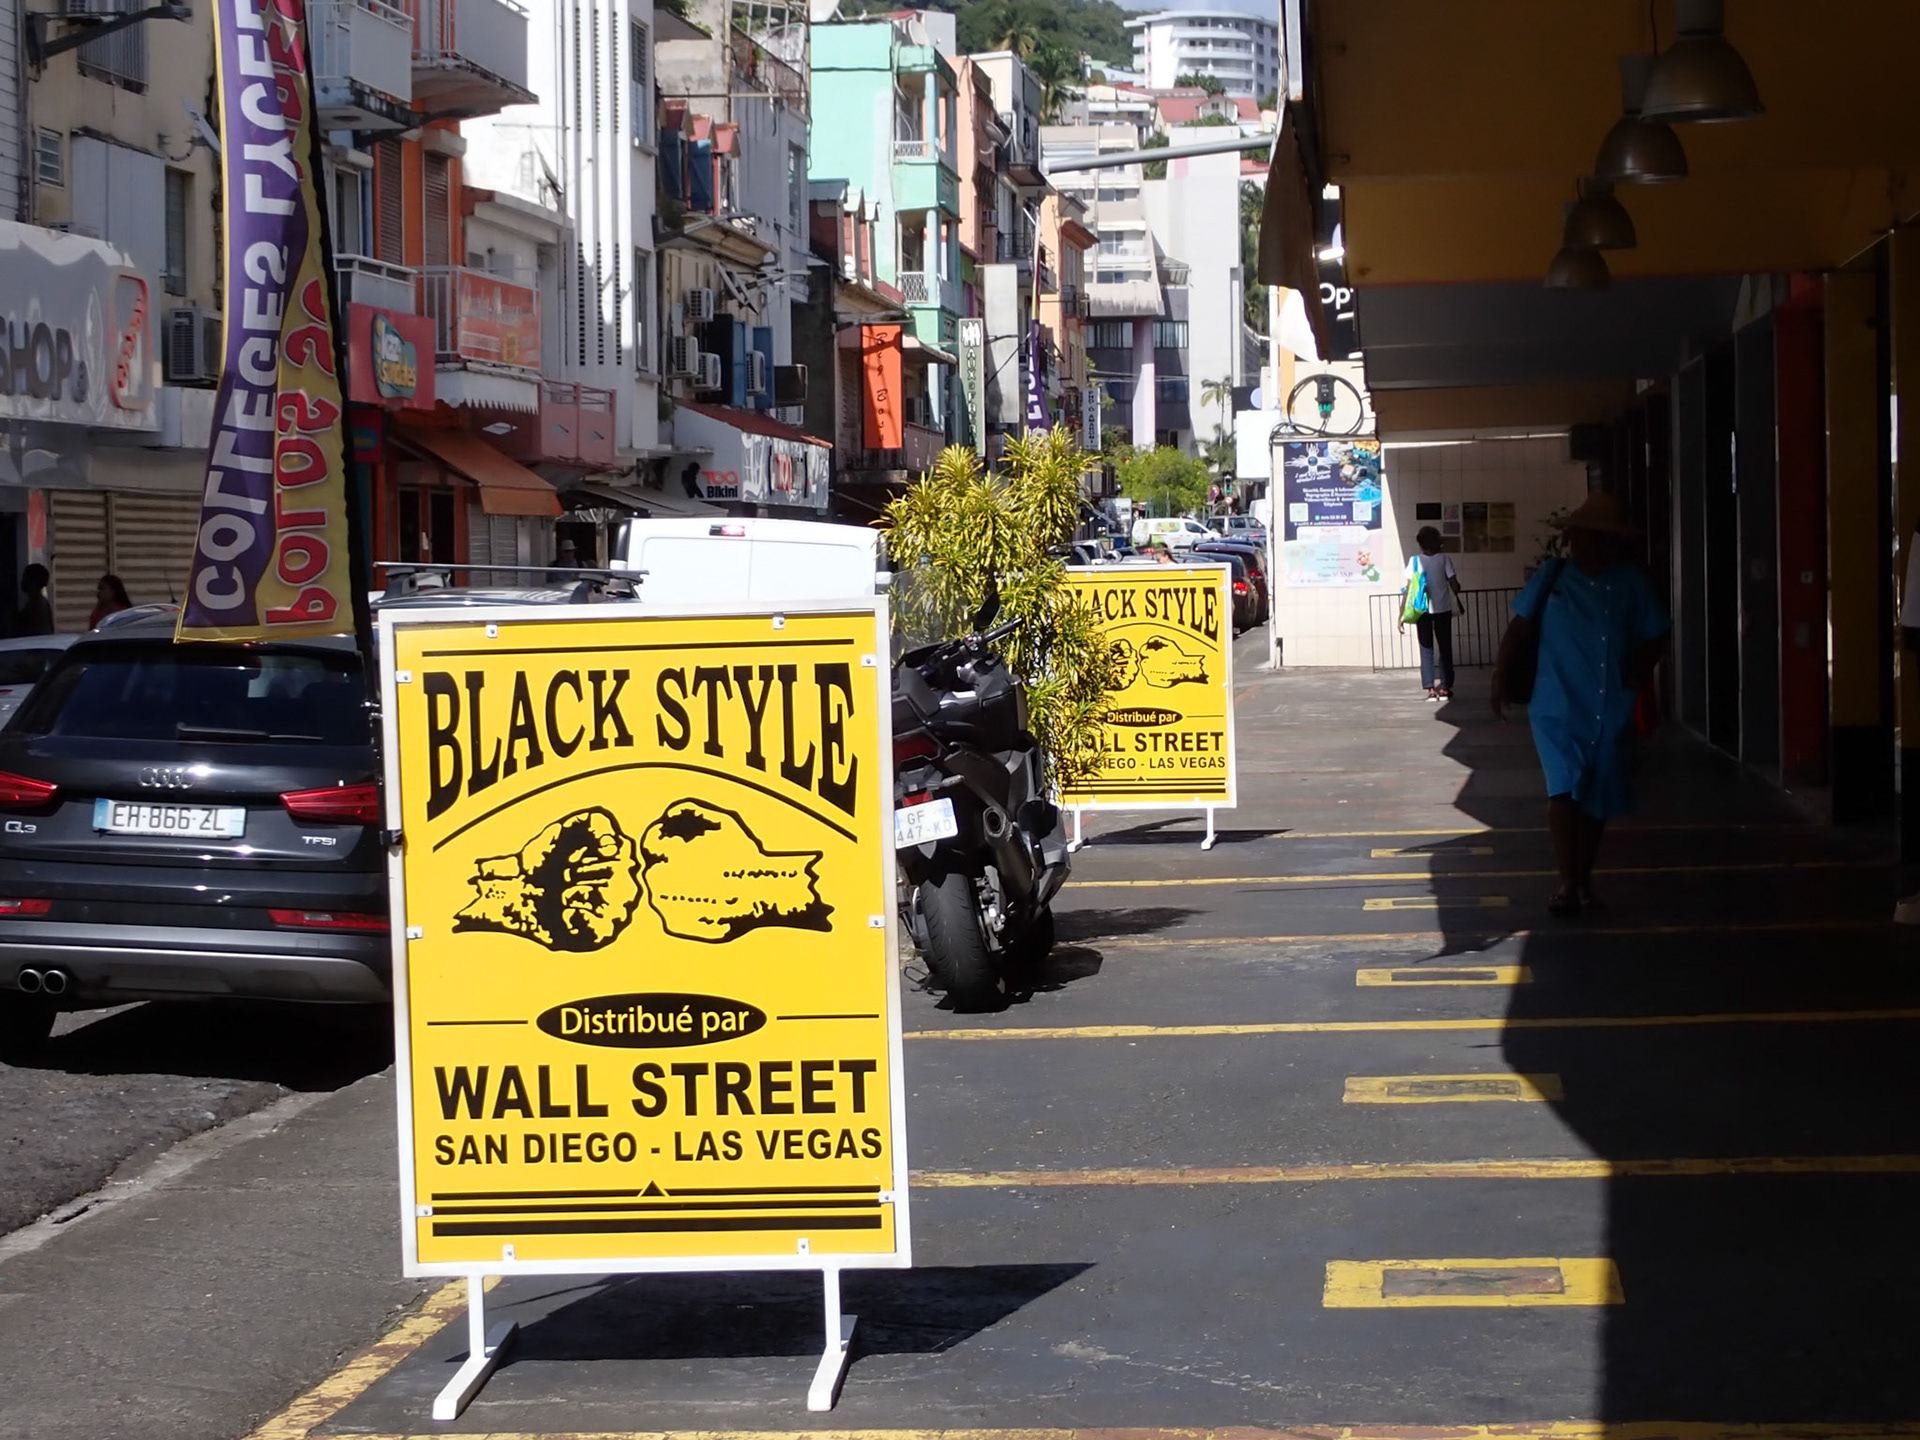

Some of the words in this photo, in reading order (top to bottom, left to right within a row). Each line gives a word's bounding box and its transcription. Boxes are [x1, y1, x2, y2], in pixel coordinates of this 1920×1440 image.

[1319, 282, 1354, 310] Op
[706, 485, 739, 499] Bikini
[1061, 588, 1136, 625] ACK
[1145, 587, 1219, 642] STYLE
[1107, 711, 1156, 723] Distribué
[1158, 713, 1177, 725] par
[422, 668, 634, 823] BLACK
[655, 662, 858, 818] STYLE
[1134, 731, 1224, 753] STREET
[1099, 757, 1137, 769] IEGO
[1149, 757, 1175, 769] LAS
[1179, 756, 1226, 769] VEGAS
[5, 821, 37, 834] Q3
[907, 810, 926, 825] GF
[301, 835, 337, 847] TFSI
[560, 1004, 693, 1035] Distribué
[701, 1008, 749, 1039] par
[434, 1064, 609, 1120] WALL
[631, 1060, 877, 1118] STREET
[434, 1133, 508, 1165] SAN
[523, 1131, 638, 1163] DIEGO
[674, 1130, 744, 1162] LAS
[756, 1127, 883, 1160] VEGAS
